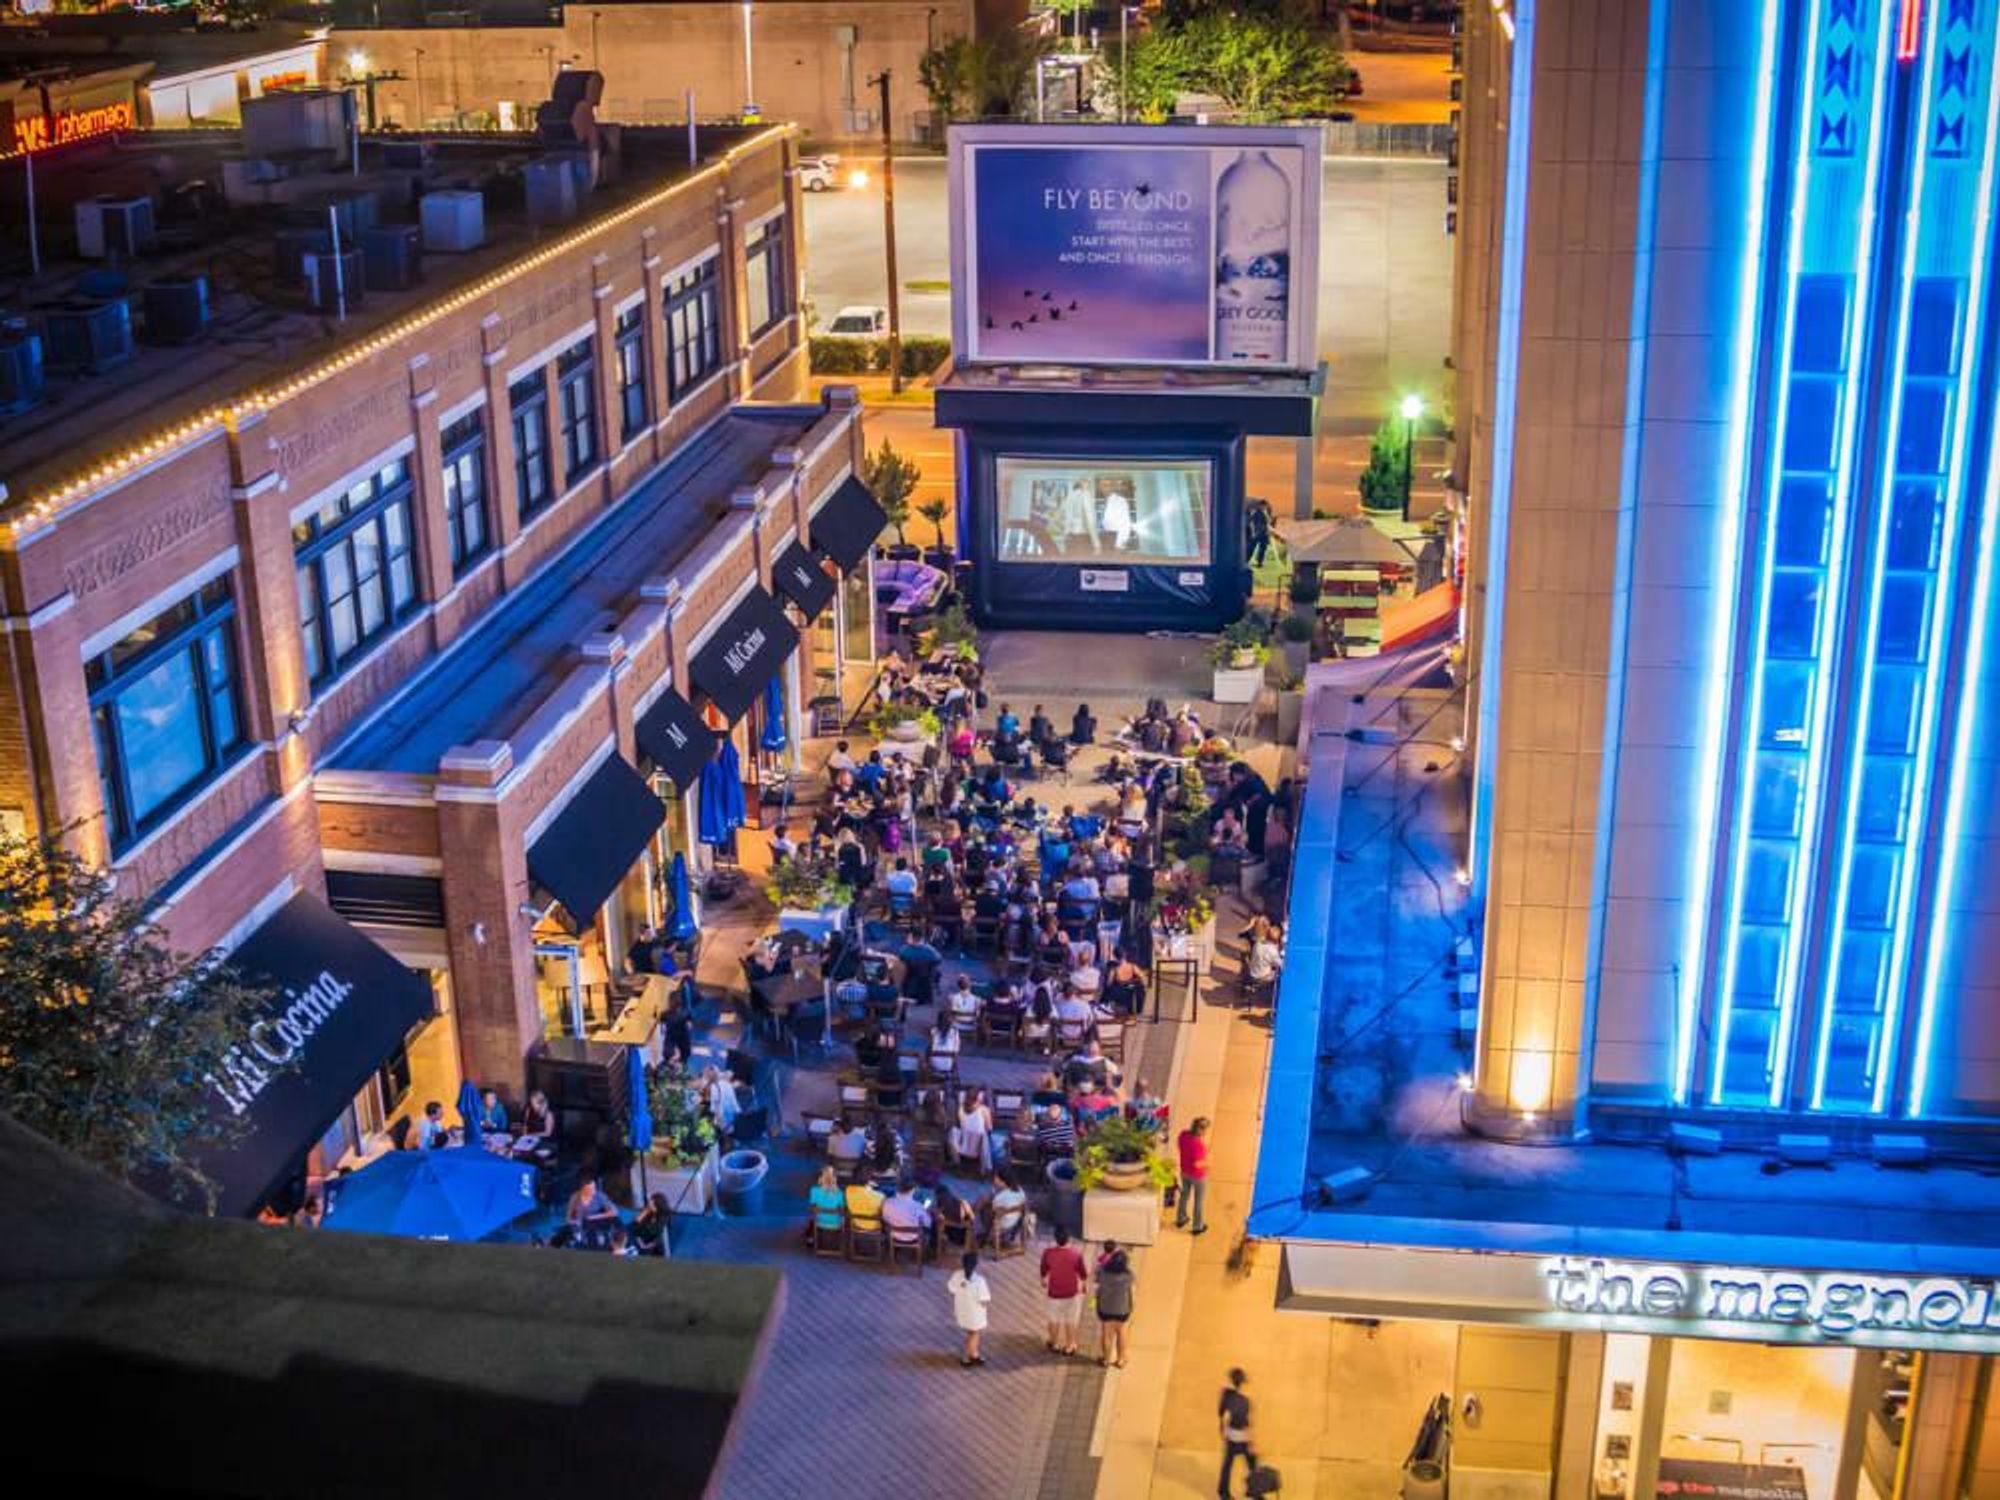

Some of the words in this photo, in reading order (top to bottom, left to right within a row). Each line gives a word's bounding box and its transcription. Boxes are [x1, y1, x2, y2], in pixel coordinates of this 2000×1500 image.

[1044, 188, 1080, 210] FLY
[1089, 187, 1192, 211] BEYOND
[1071, 235, 1106, 247] START
[1108, 236, 1138, 247] WITH
[1139, 236, 1161, 247] THE
[1059, 252, 1086, 263] AND
[1087, 252, 1121, 264] ONCE
[723, 653, 746, 674] Mi
[1548, 1257, 1684, 1315] the
